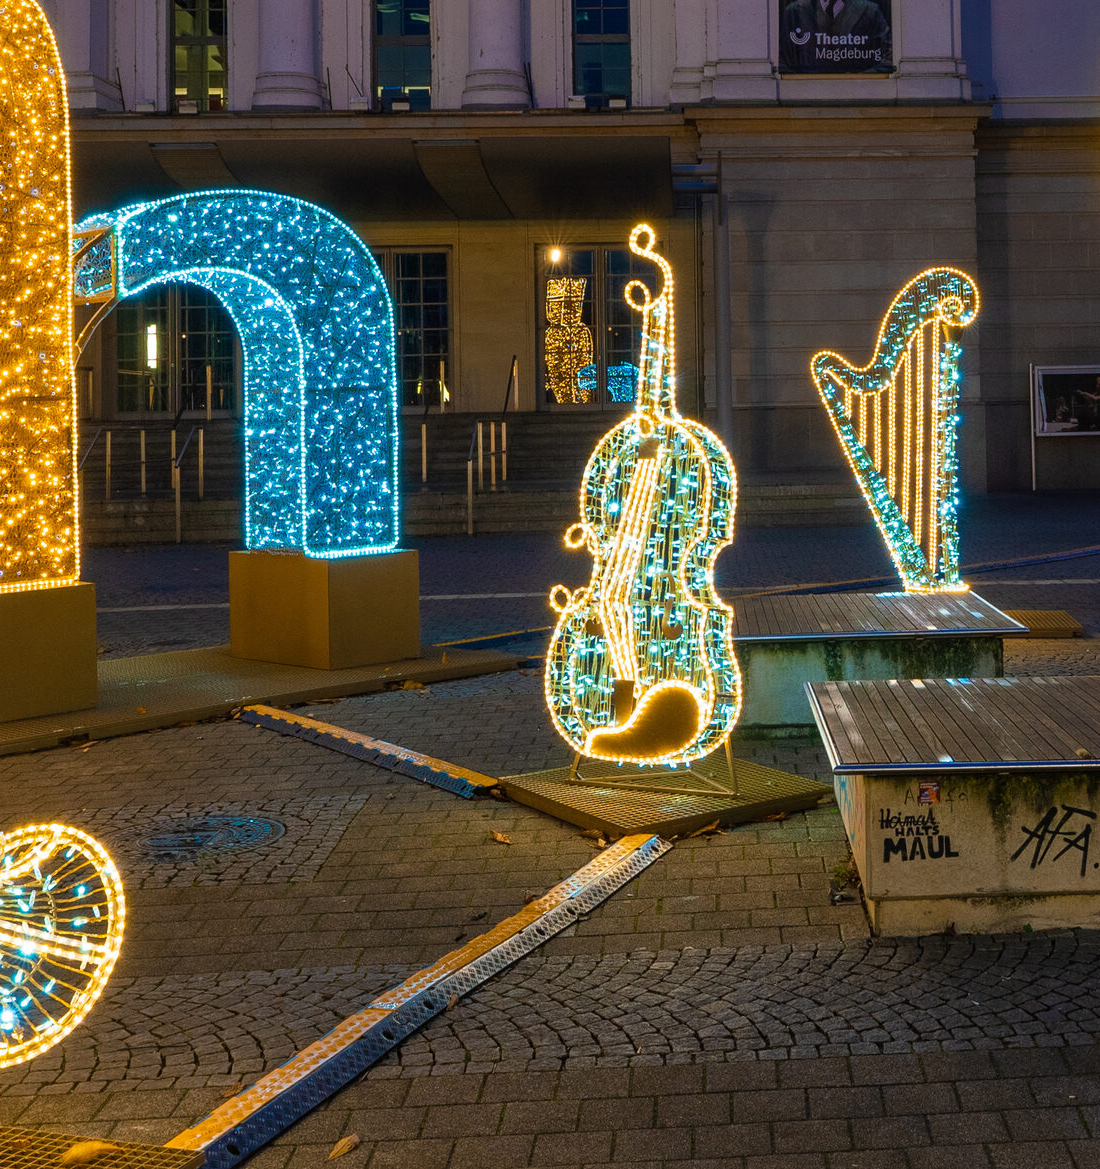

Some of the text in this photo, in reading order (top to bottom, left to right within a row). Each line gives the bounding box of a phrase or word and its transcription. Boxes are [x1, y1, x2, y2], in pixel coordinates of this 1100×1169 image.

[815, 33, 869, 45] Theater
[816, 47, 881, 61] Magdeburg
[895, 825, 939, 837] HALTS
[883, 835, 959, 863] MAUL
